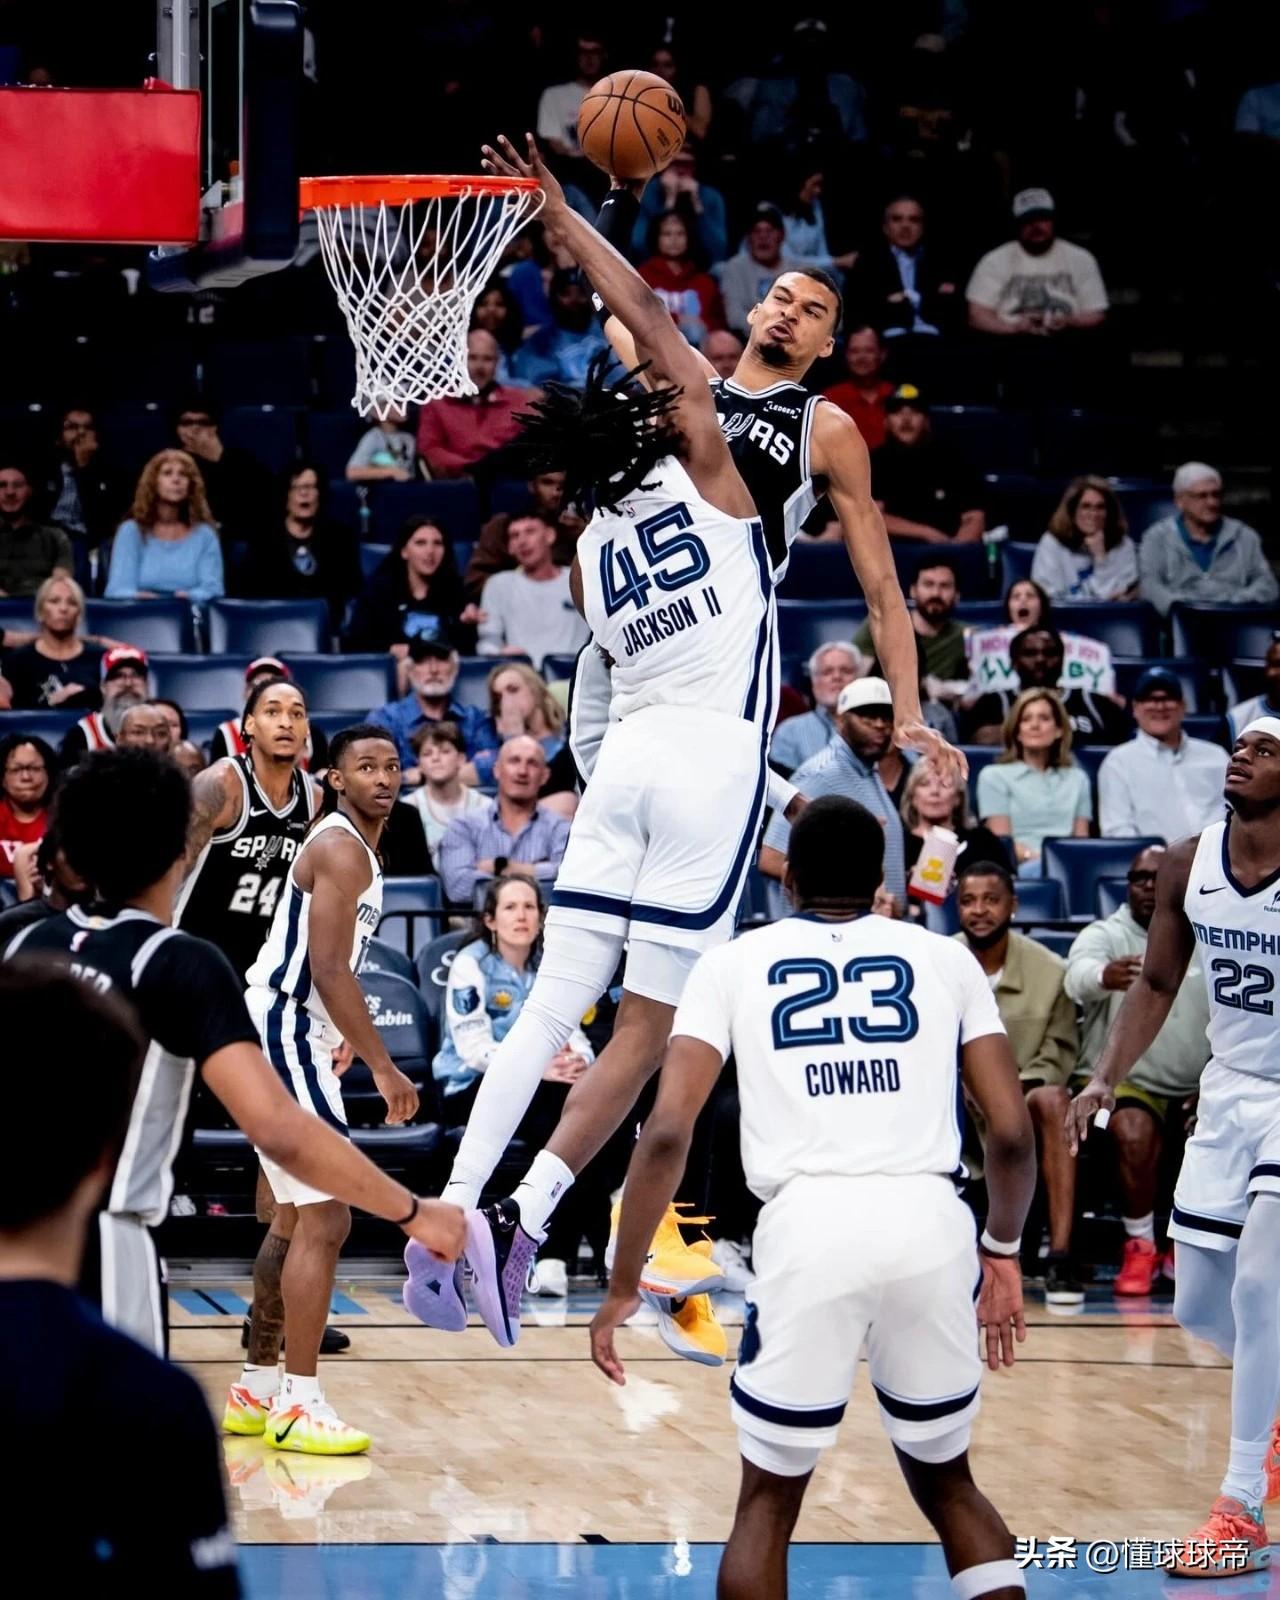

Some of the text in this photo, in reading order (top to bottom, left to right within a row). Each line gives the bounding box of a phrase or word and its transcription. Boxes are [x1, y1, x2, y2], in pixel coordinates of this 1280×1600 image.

[769, 403, 796, 416] LEDGER
[600, 501, 711, 619] 45
[622, 586, 722, 657] JACKSON II
[231, 835, 301, 864] SPUR
[228, 873, 282, 917] 24
[767, 955, 919, 1051] 23
[1211, 958, 1275, 1016] 22
[805, 1058, 901, 1097] COWARD
